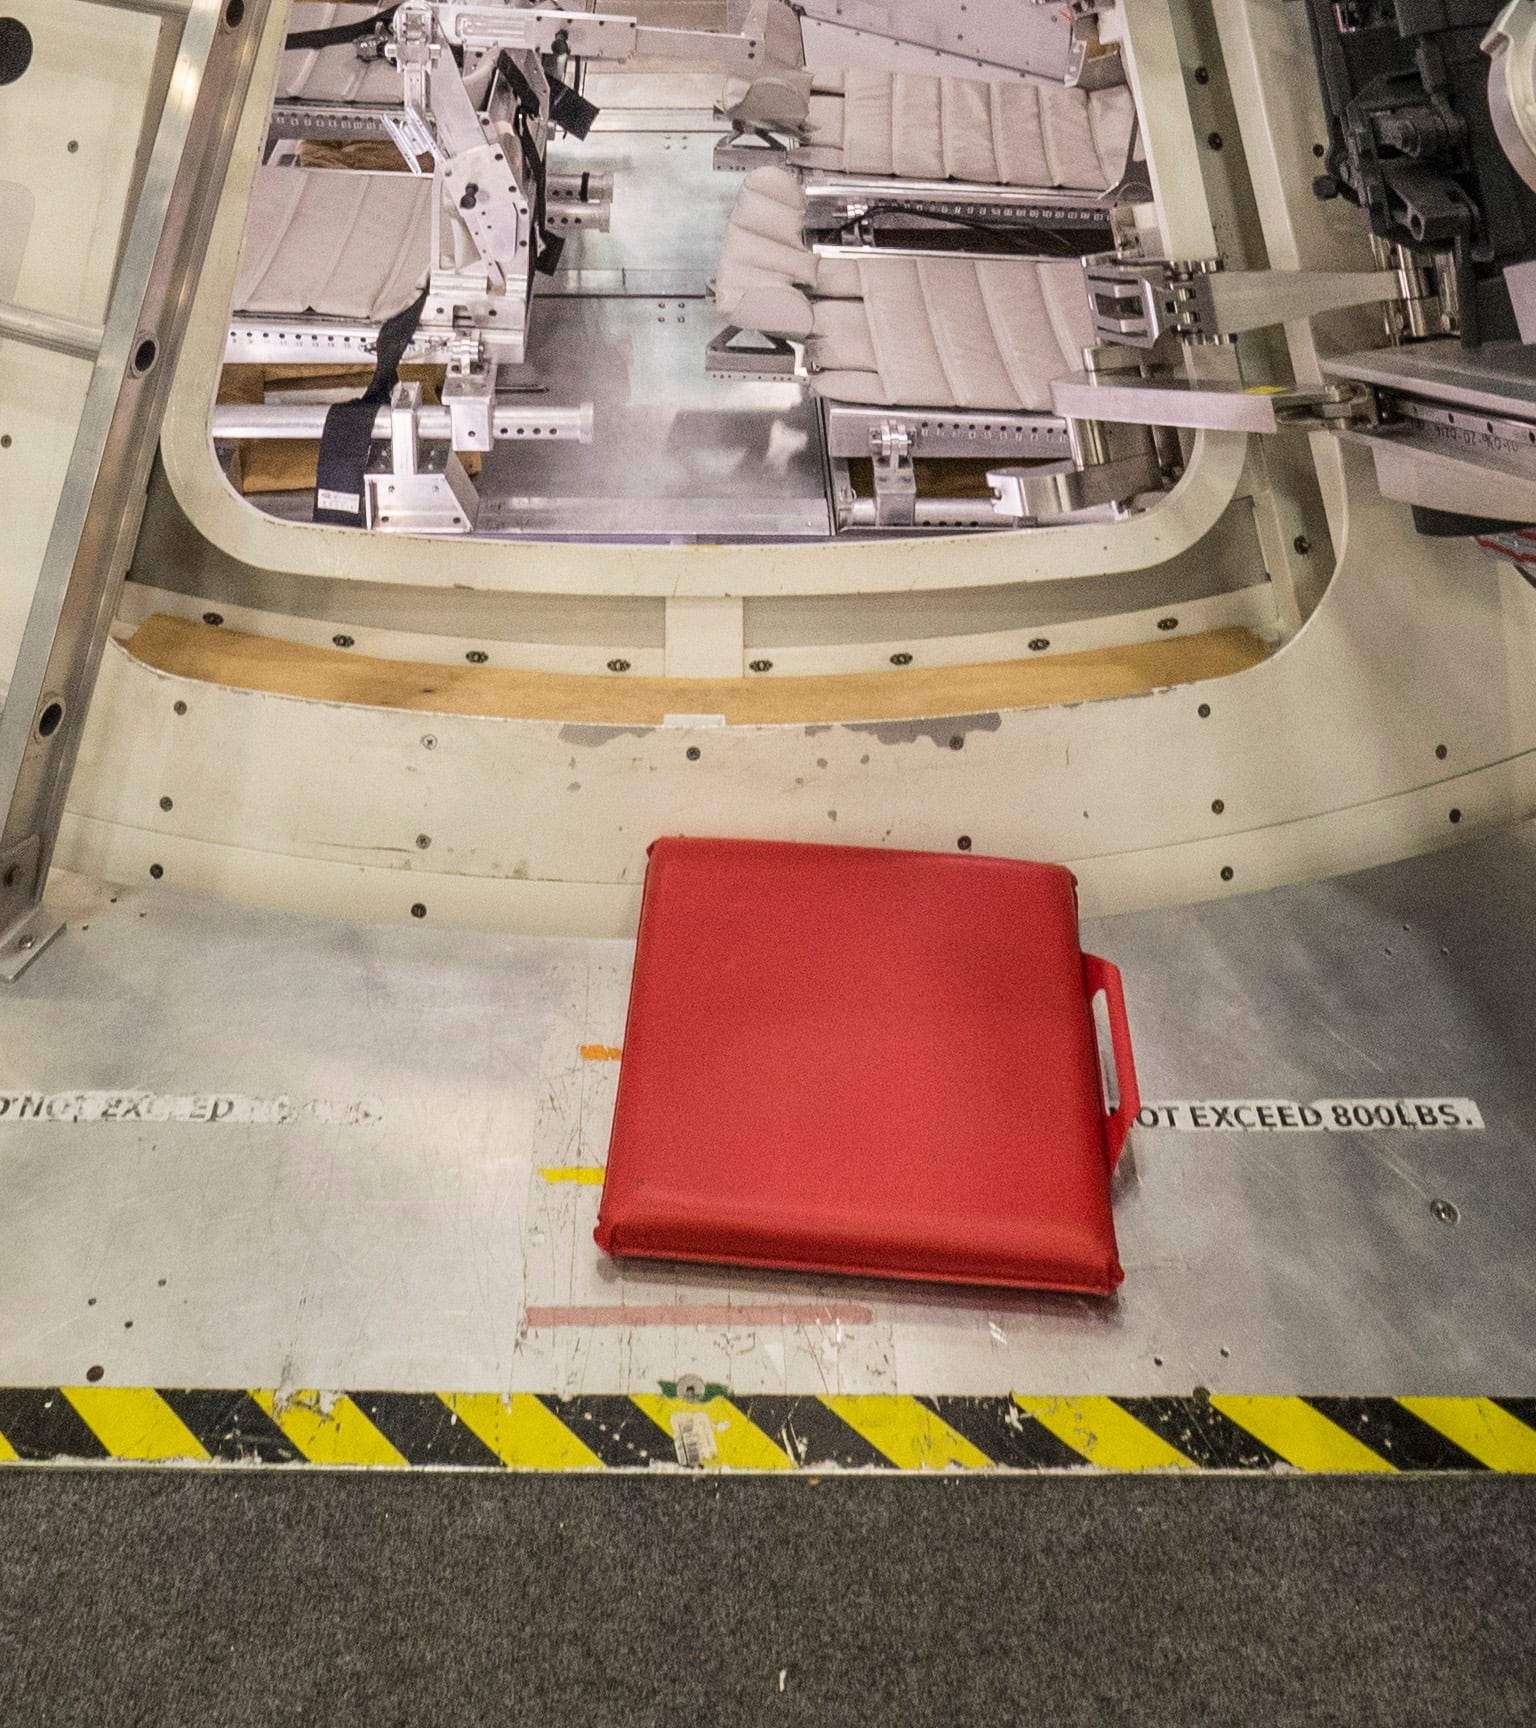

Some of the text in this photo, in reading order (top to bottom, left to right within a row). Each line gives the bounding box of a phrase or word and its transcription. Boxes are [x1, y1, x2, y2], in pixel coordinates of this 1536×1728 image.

[1120, 1102, 1474, 1129] OT EXCEED 800LBS.
